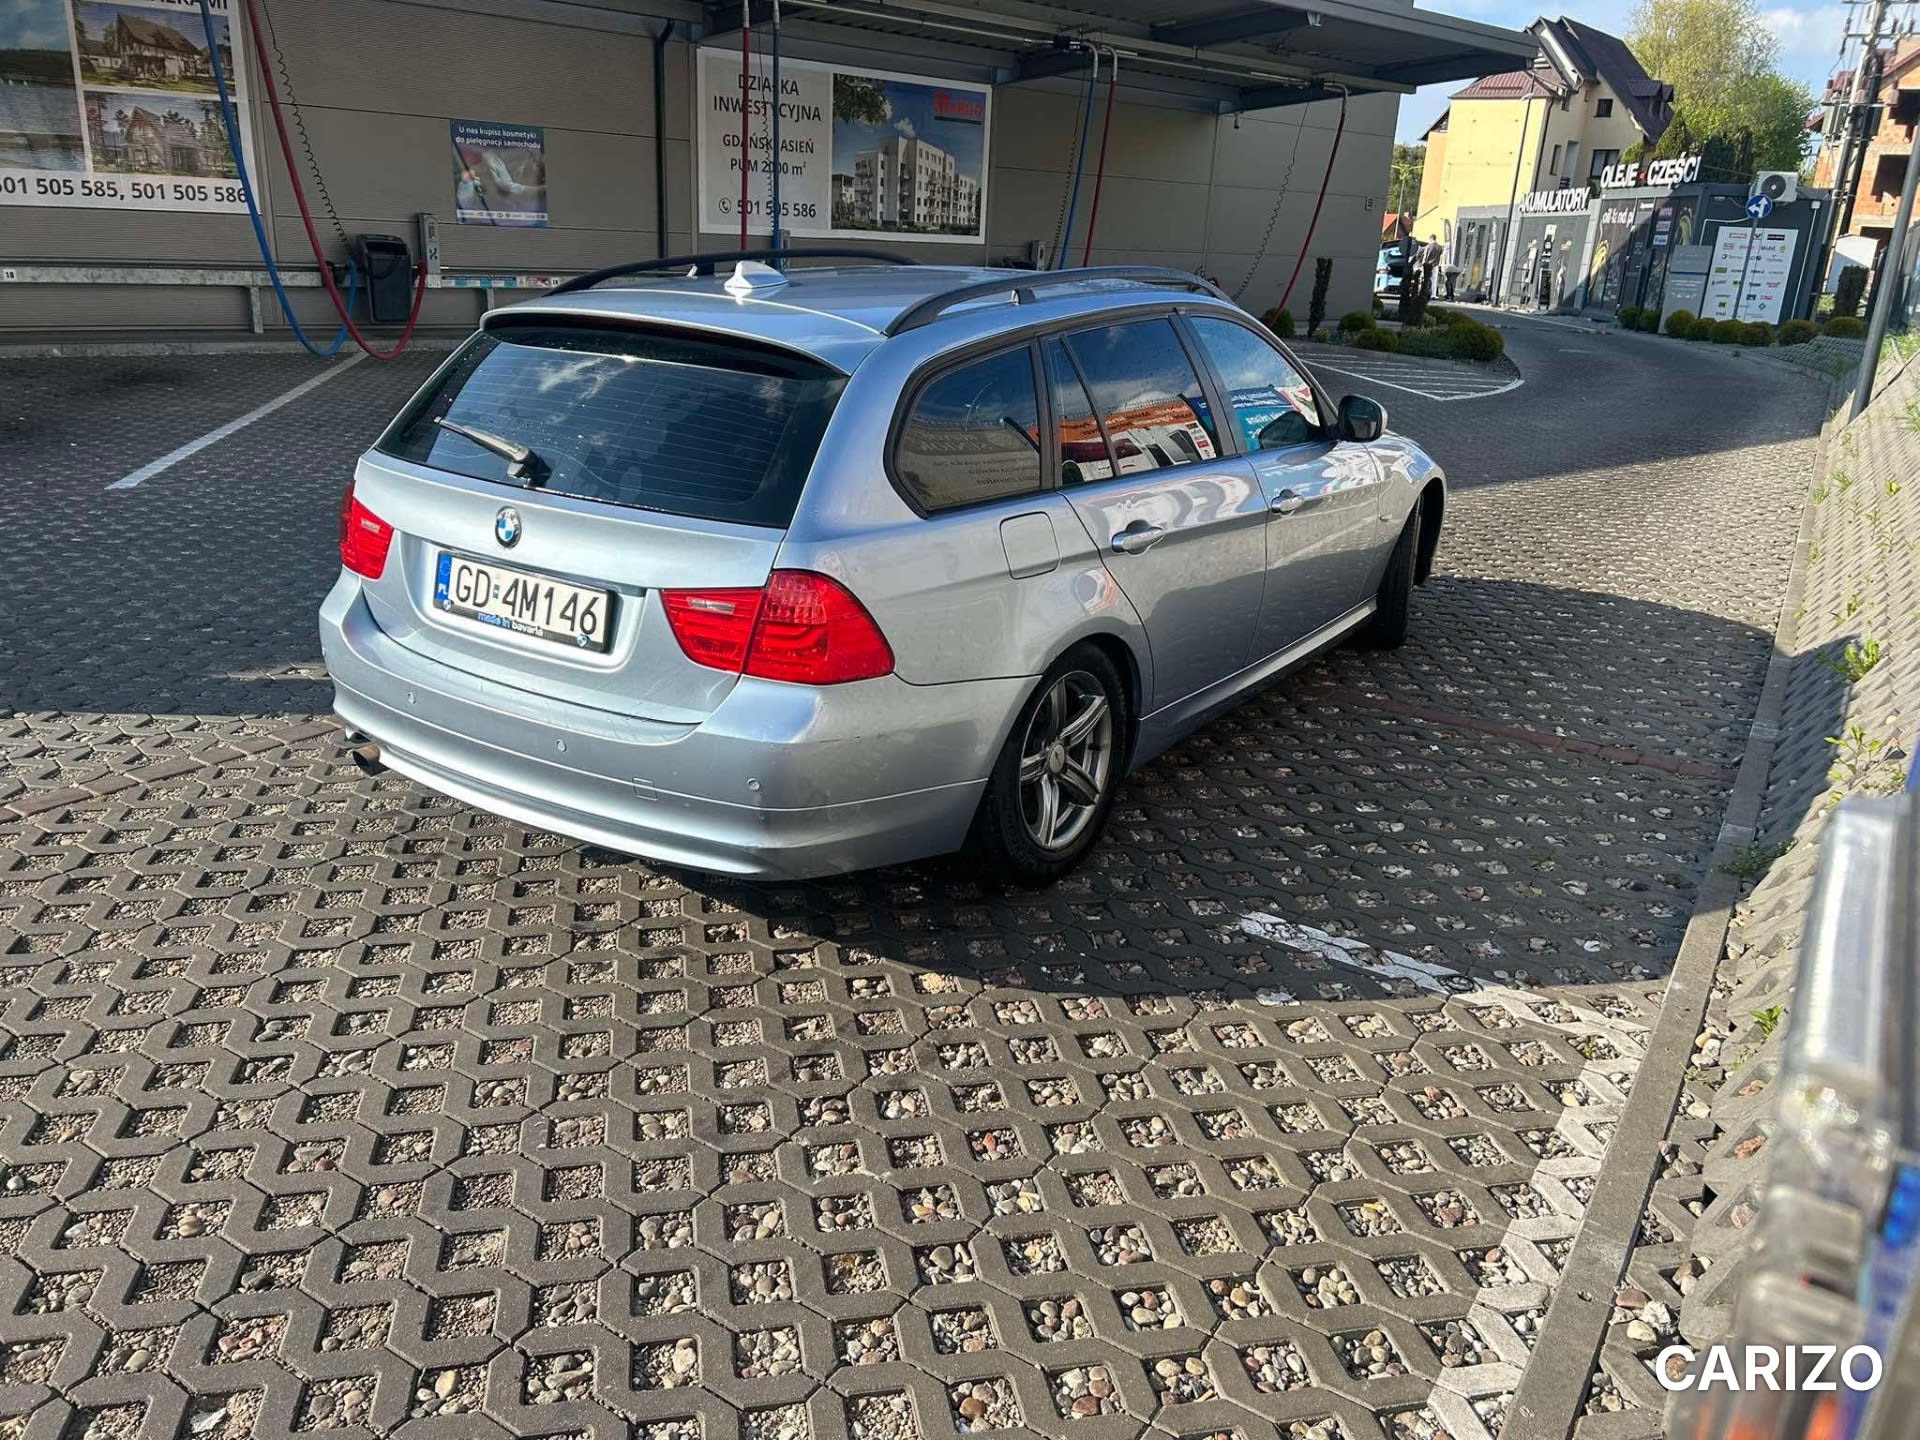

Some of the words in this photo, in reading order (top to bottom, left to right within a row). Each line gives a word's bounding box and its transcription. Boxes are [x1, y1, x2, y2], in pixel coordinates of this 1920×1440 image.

[738, 74, 800, 96] DZIAKA
[722, 133, 773, 151] GDŃSK
[778, 138, 815, 154] ASIEŃ
[1601, 163, 1640, 188] OLEJE
[1647, 152, 1702, 189] CZĘŚCI
[0, 176, 27, 194] 01
[36, 178, 74, 196] 505
[81, 180, 125, 200] 585,
[131, 182, 166, 200] 501
[174, 184, 209, 202] 505
[214, 187, 247, 203] 586
[793, 203, 816, 218] 586
[438, 584, 448, 595] PL
[455, 564, 492, 608] GD
[501, 578, 600, 635] 4M146
[502, 616, 511, 629] in
[511, 619, 544, 637] bavaria
